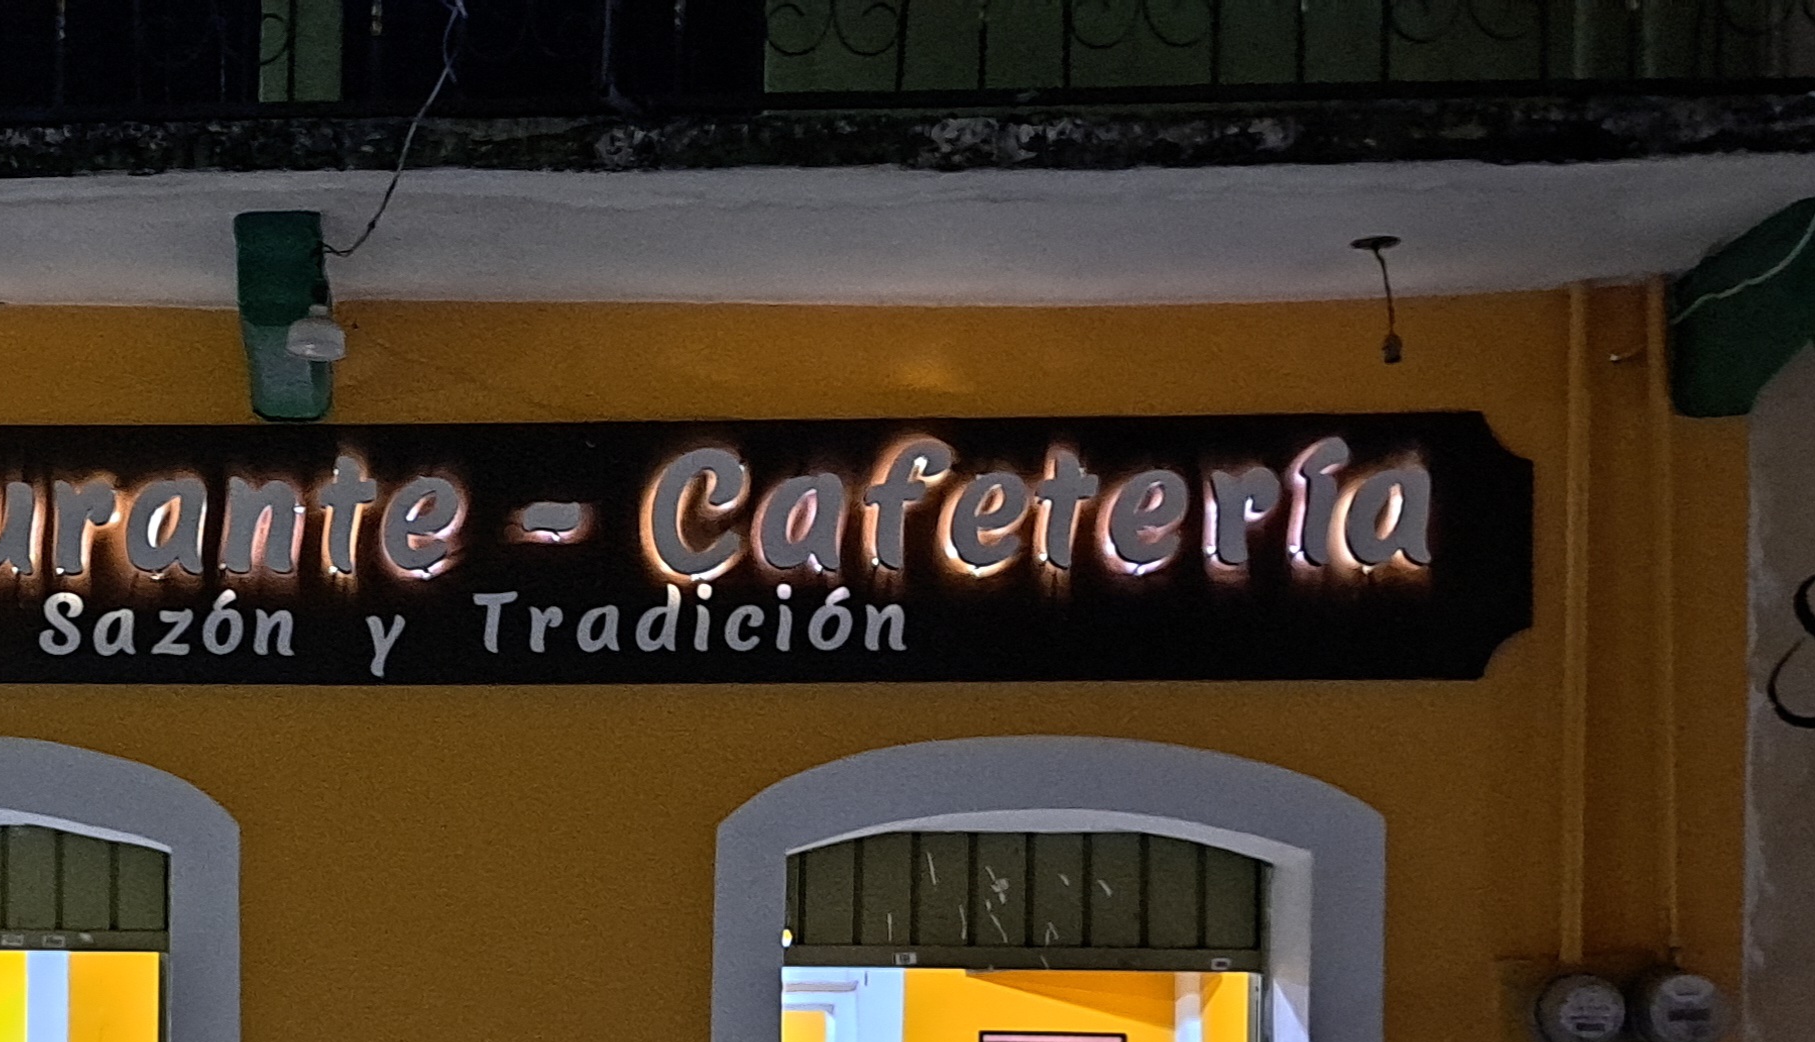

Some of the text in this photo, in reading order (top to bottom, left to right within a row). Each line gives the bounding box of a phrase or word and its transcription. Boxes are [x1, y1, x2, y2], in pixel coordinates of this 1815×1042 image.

[648, 438, 1434, 575] Cafetería
[38, 584, 908, 677] Sazón y Tradición
